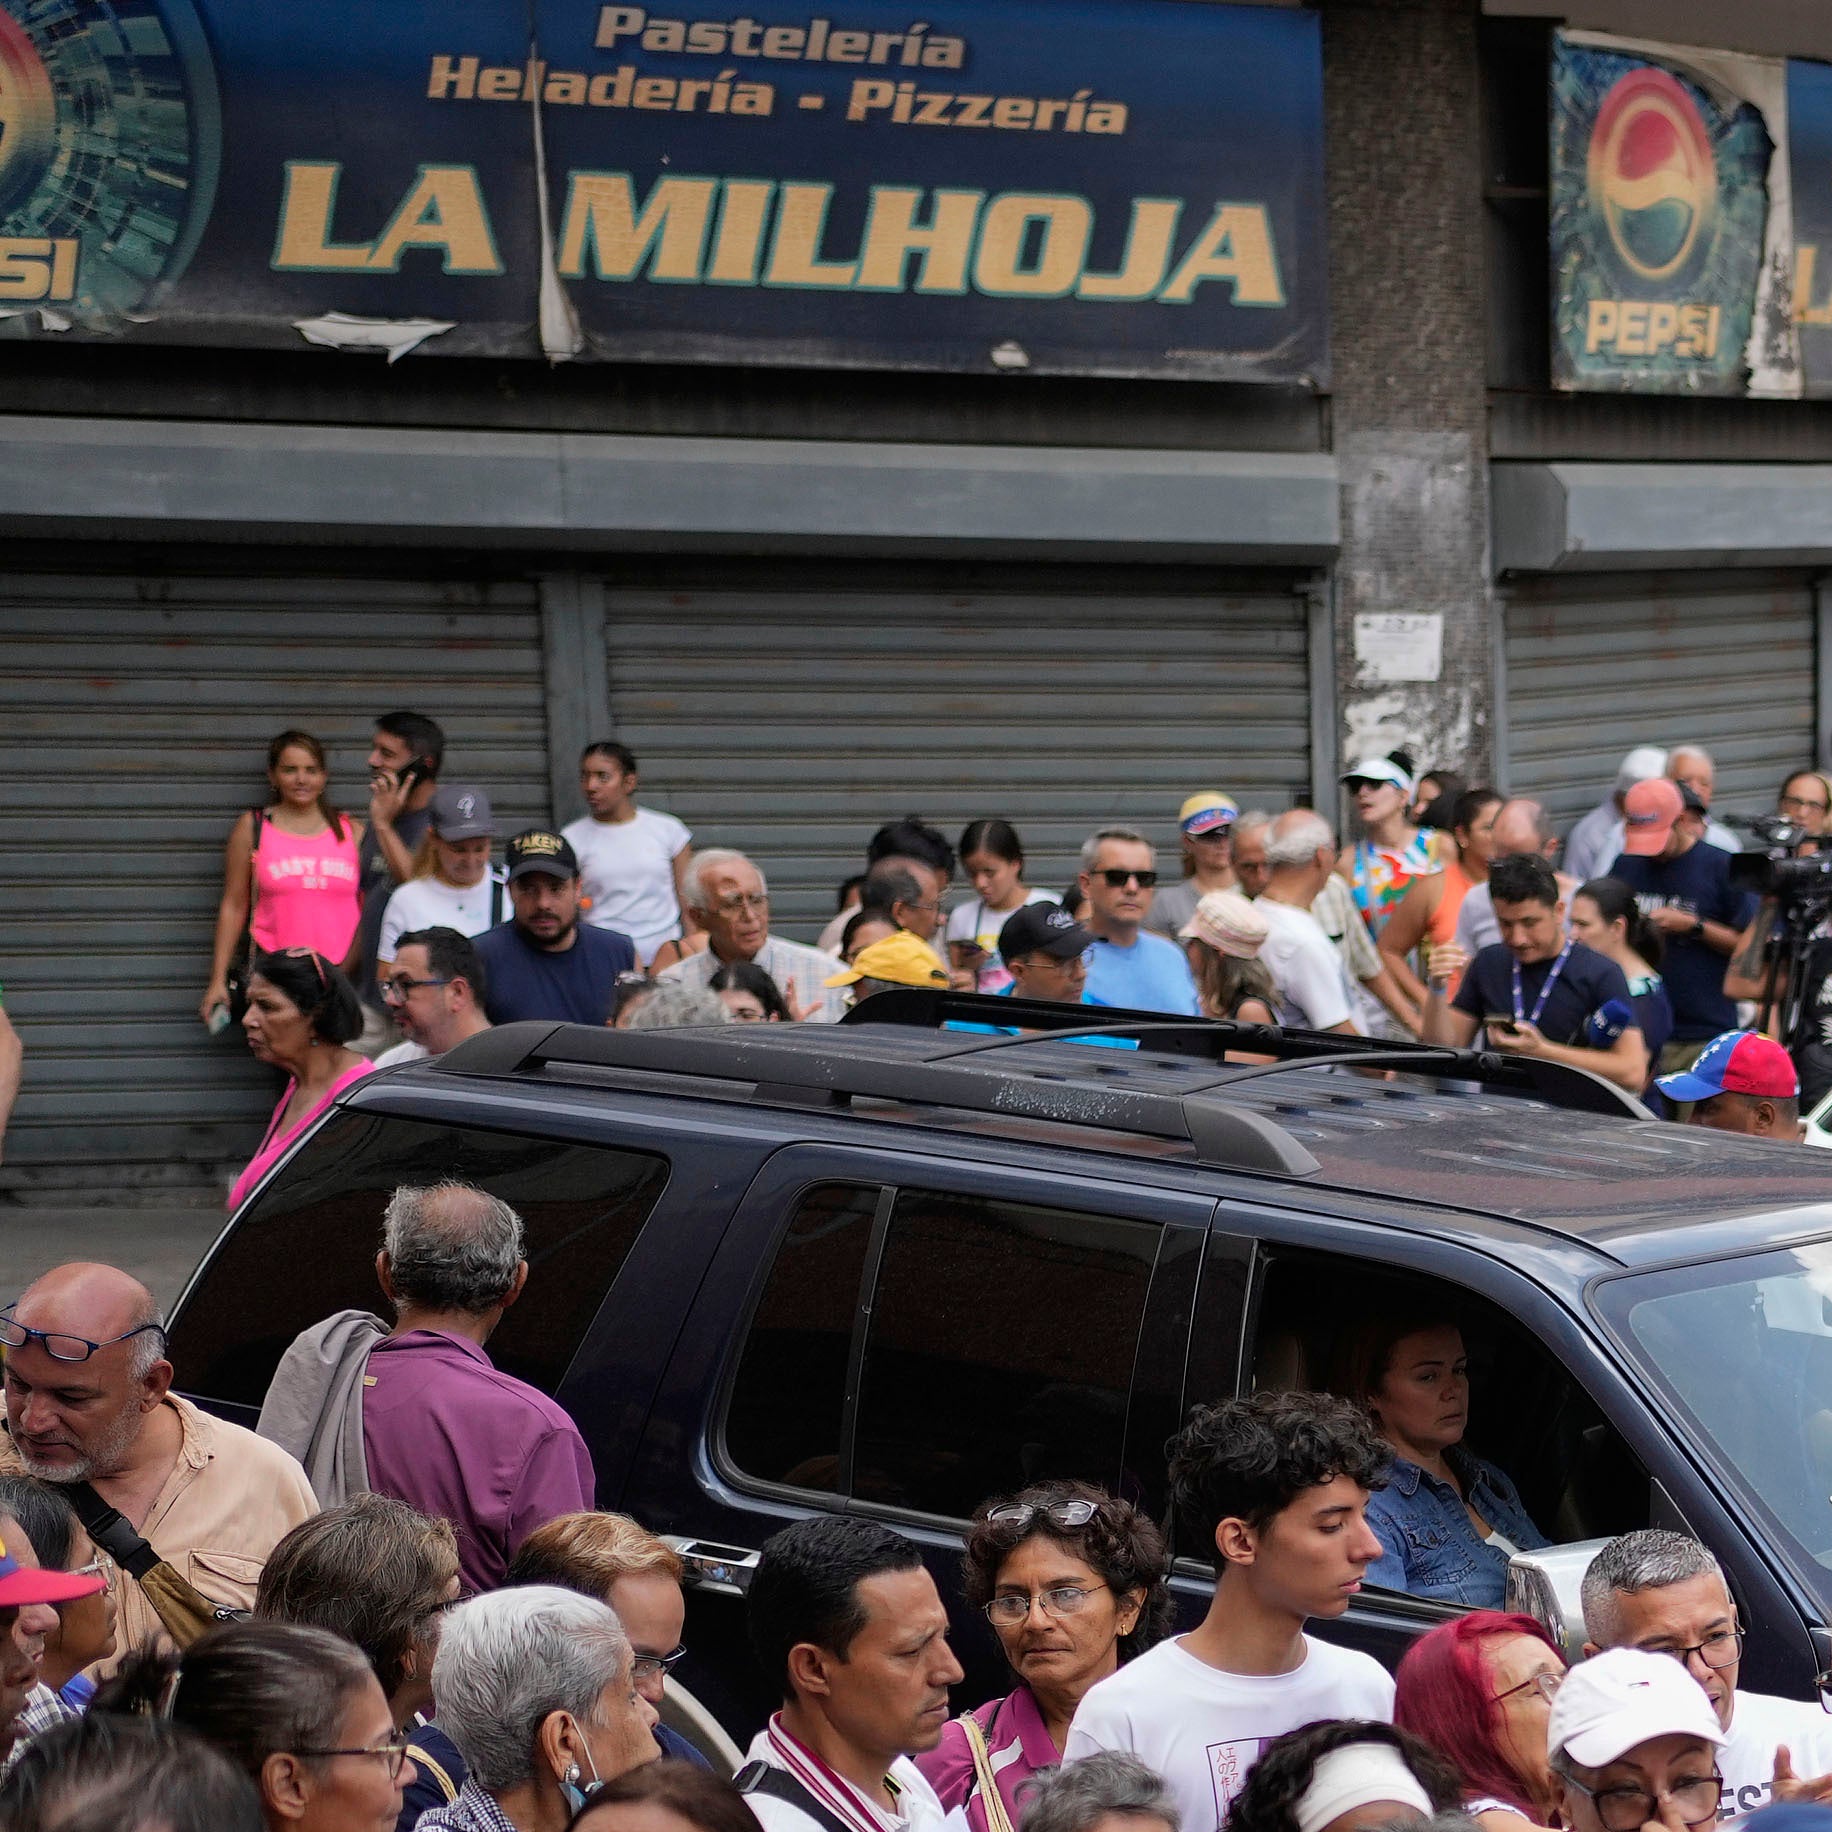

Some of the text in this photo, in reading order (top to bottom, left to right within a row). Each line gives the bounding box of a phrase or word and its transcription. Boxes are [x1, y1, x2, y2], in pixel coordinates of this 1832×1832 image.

[595, 5, 965, 69] Pastelería
[428, 56, 775, 117] Heladería
[846, 78, 1129, 136] Pizzería
[272, 160, 1287, 308] LA MILHOJA
[1586, 301, 1720, 358] PEPSI
